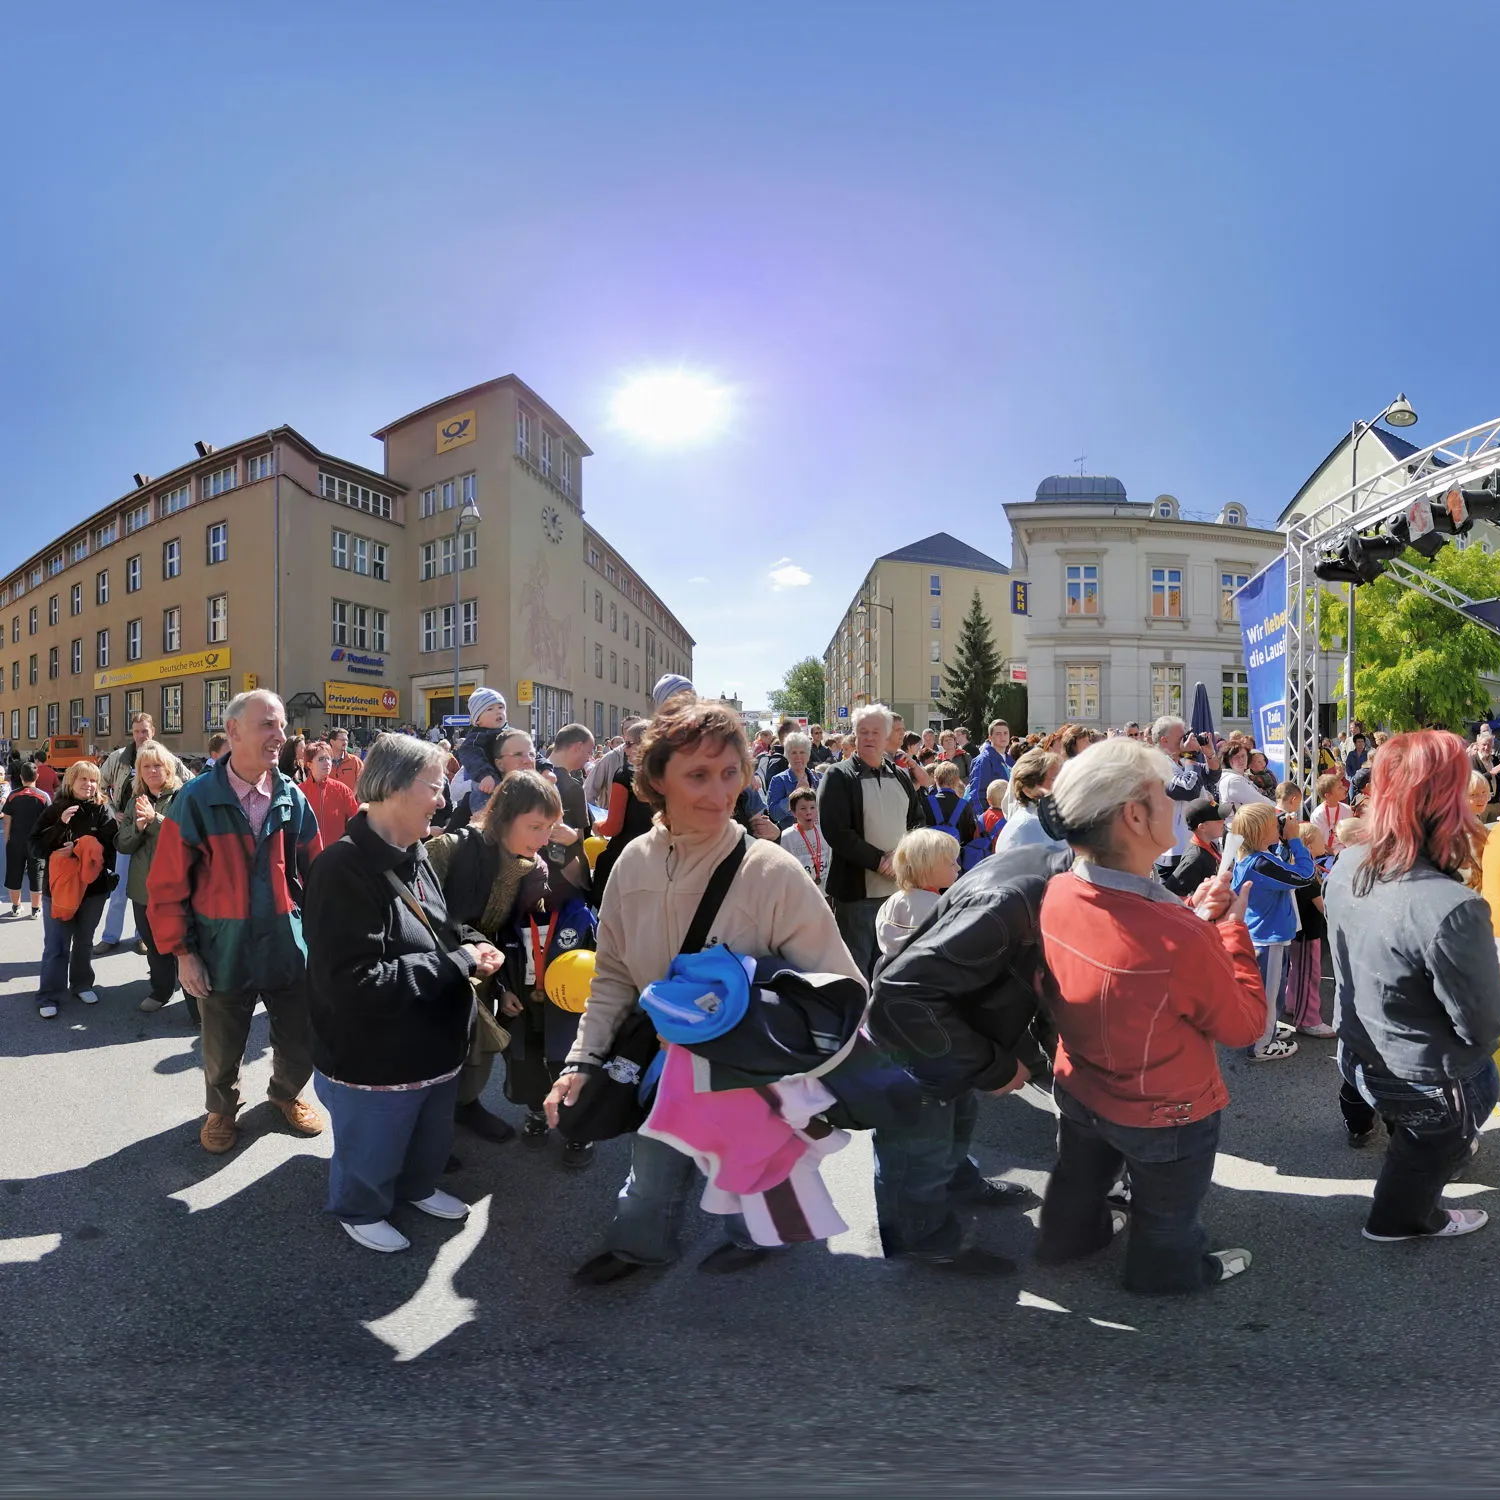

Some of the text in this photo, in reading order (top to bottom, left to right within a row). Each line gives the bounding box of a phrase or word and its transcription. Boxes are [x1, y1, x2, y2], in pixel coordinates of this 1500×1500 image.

[1016, 584, 1025, 611] KKH
[1246, 623, 1264, 645] Wir
[1249, 633, 1287, 668] die Lausi
[159, 661, 188, 674] Deutsche
[189, 660, 204, 670] Post
[348, 653, 384, 666] Postbank
[329, 694, 379, 706] Privatkredit
[1267, 709, 1281, 724] Radio
